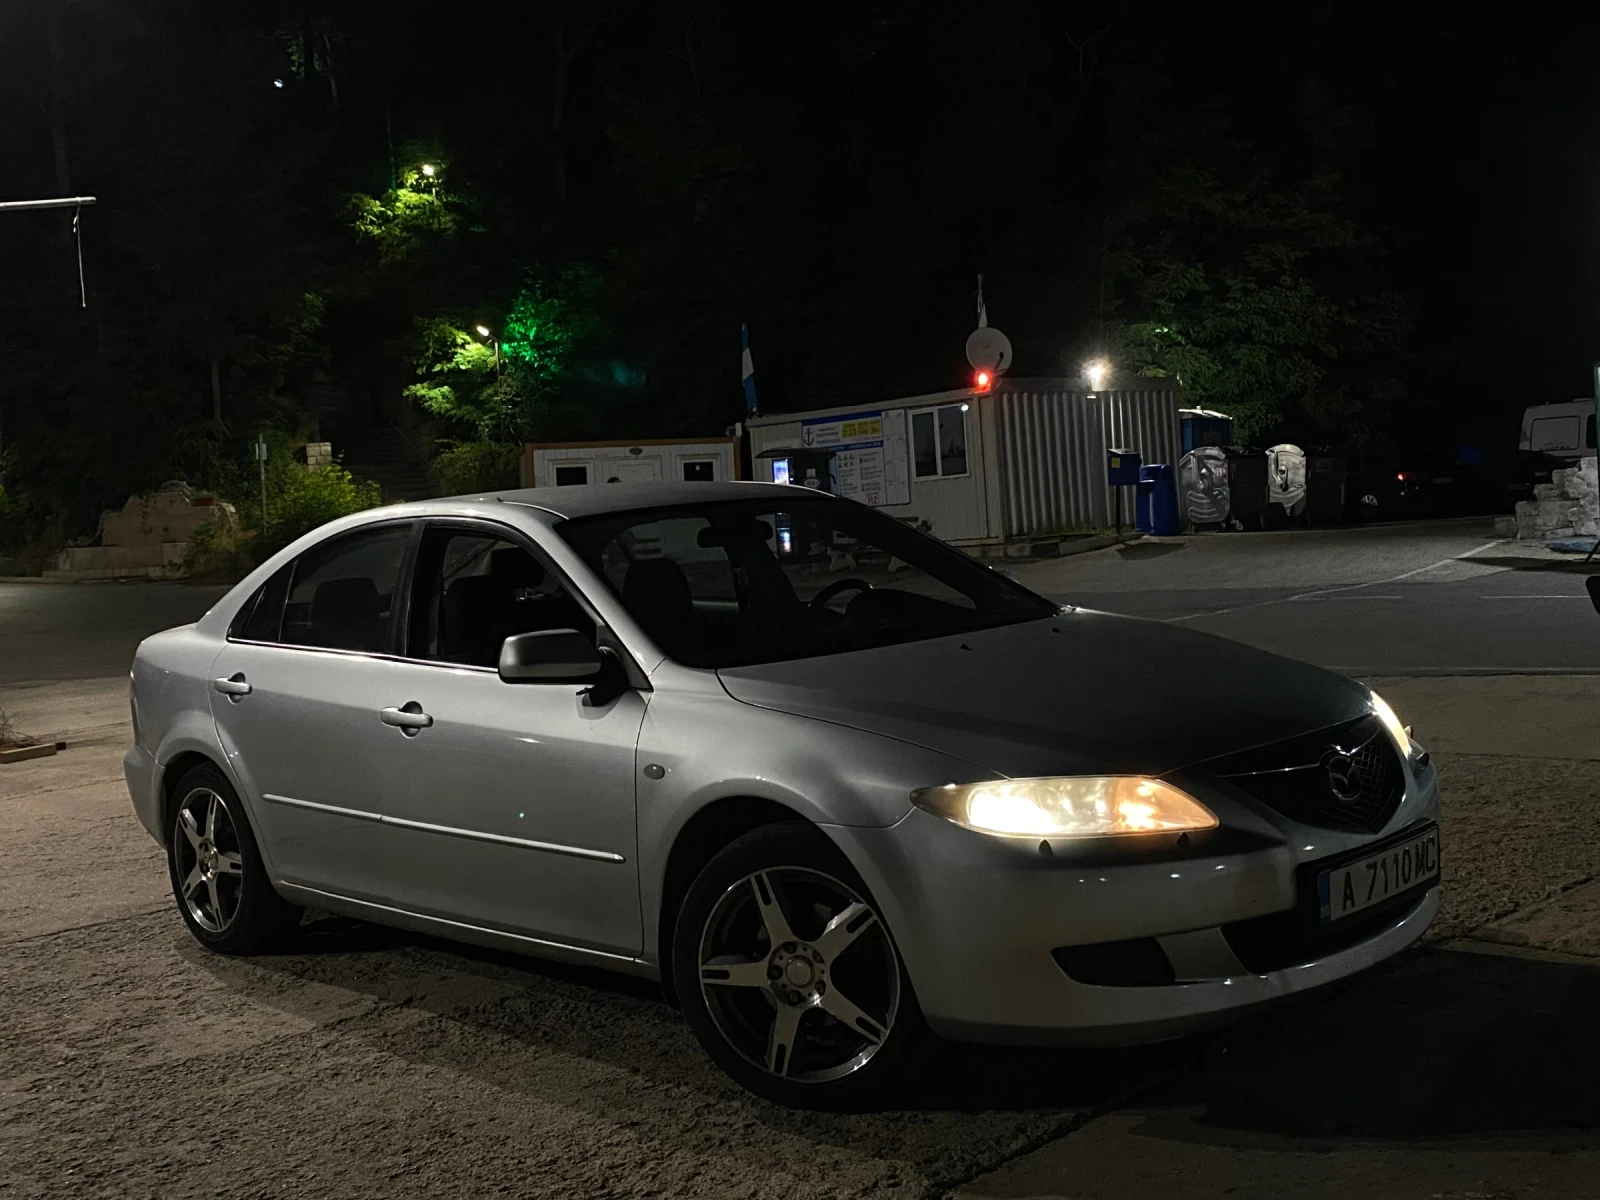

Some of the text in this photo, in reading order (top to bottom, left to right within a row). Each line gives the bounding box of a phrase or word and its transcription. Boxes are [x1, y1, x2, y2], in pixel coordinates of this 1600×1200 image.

[867, 495, 878, 504] 112
[1343, 837, 1436, 911] A 7110 MC
